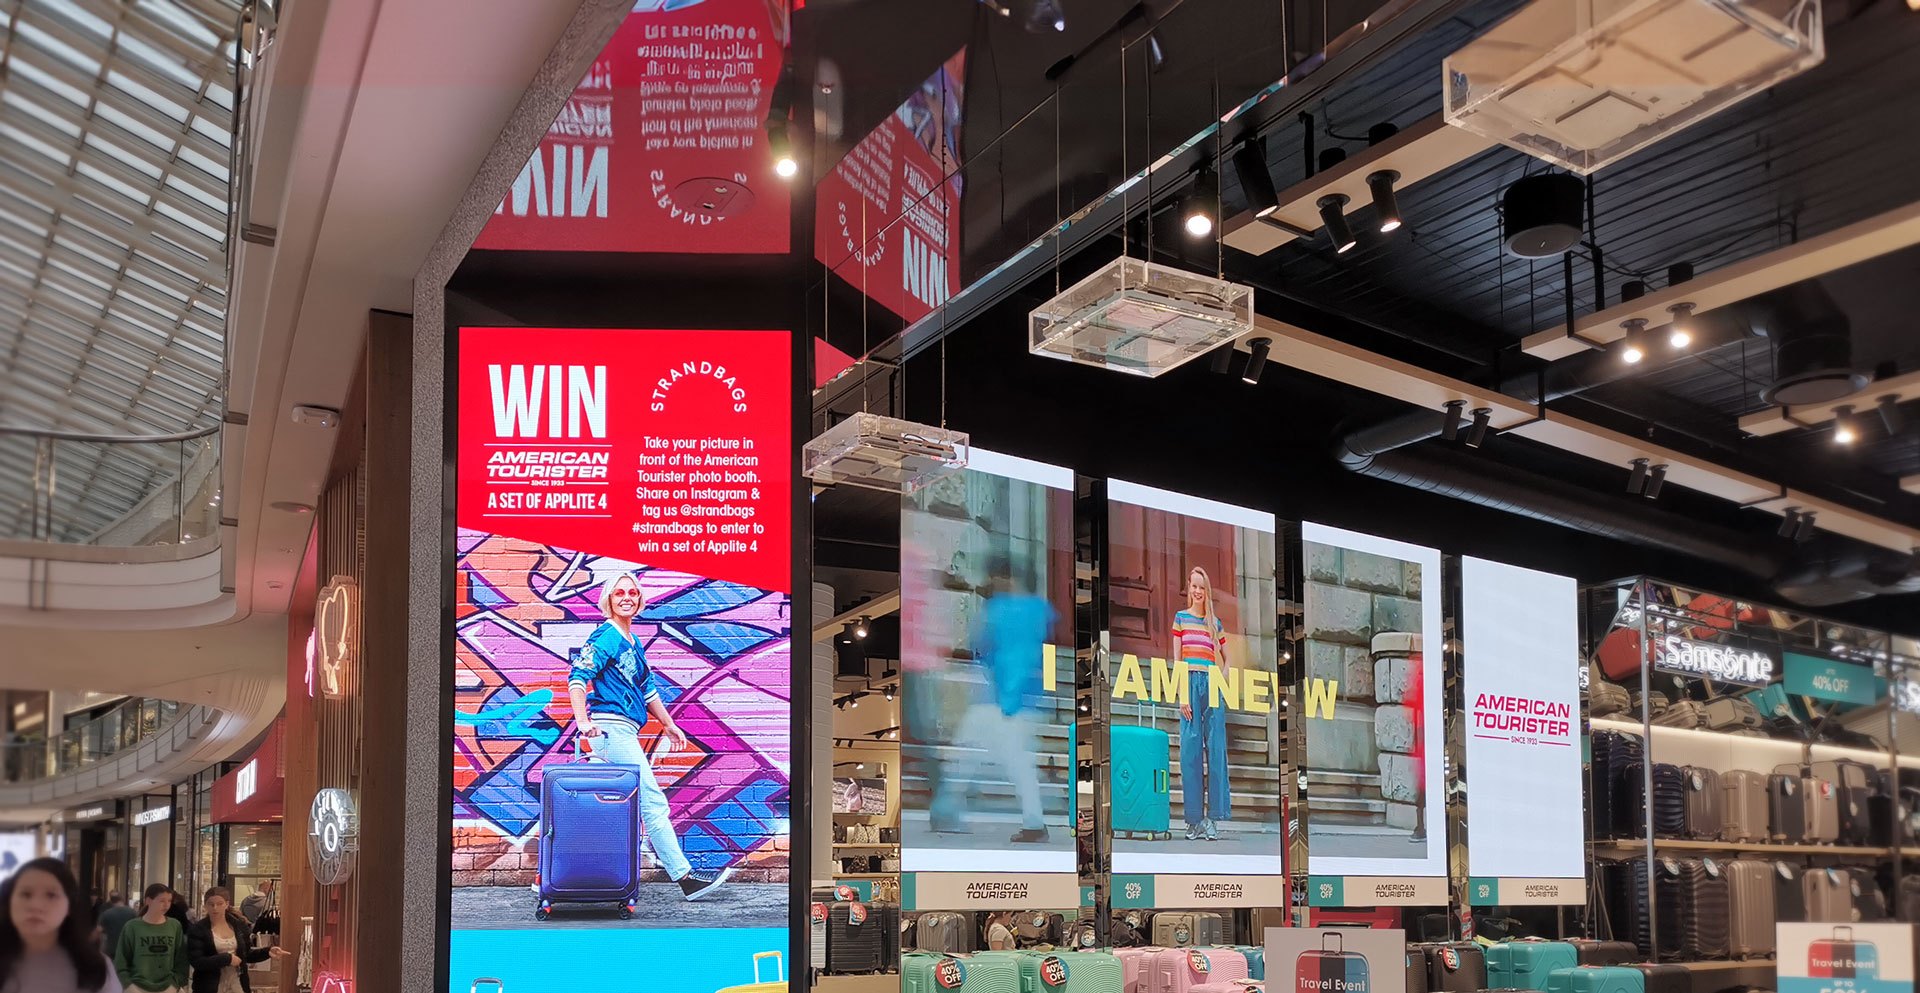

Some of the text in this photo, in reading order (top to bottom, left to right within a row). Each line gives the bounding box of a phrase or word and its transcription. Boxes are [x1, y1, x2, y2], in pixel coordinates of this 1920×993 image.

[651, 360, 748, 413] STRANDBAGS
[488, 364, 606, 438] WIN
[644, 436, 754, 451] Take your picture in
[488, 451, 609, 464] AMERICAN
[640, 453, 758, 466] front of the American
[487, 465, 607, 478] TOURISTER
[637, 470, 761, 485] Tourister photo booth.
[488, 492, 607, 509] A SET OF APPLITE 4
[636, 487, 760, 502] Share on Instagram &
[642, 504, 755, 519] tag us @strandbags
[632, 522, 765, 536] #strandbags to enter to
[638, 540, 758, 555] win a set of Applite 4
[1665, 635, 1773, 682] Samsonite
[1043, 644, 1056, 691] I
[1111, 653, 1189, 704] AM
[1475, 693, 1570, 718] AMERICAN
[1474, 712, 1569, 736] TOURISTER
[1511, 736, 1525, 744] SINCE
[967, 882, 1028, 891] AMERICAN
[1125, 882, 1141, 891] 40%
[1194, 883, 1242, 891] AMERICAN
[966, 891, 1028, 899] TOURISTER
[1126, 891, 1141, 899] OFF
[1194, 891, 1242, 899] TOURISTER
[141, 935, 174, 946] NIKE
[941, 964, 960, 975] 40%
[1046, 961, 1064, 973] 40%
[1812, 958, 1875, 969] Travel Event
[945, 972, 961, 984] OFF
[1050, 970, 1065, 981] OFF
[1300, 978, 1366, 992] Travel Event
